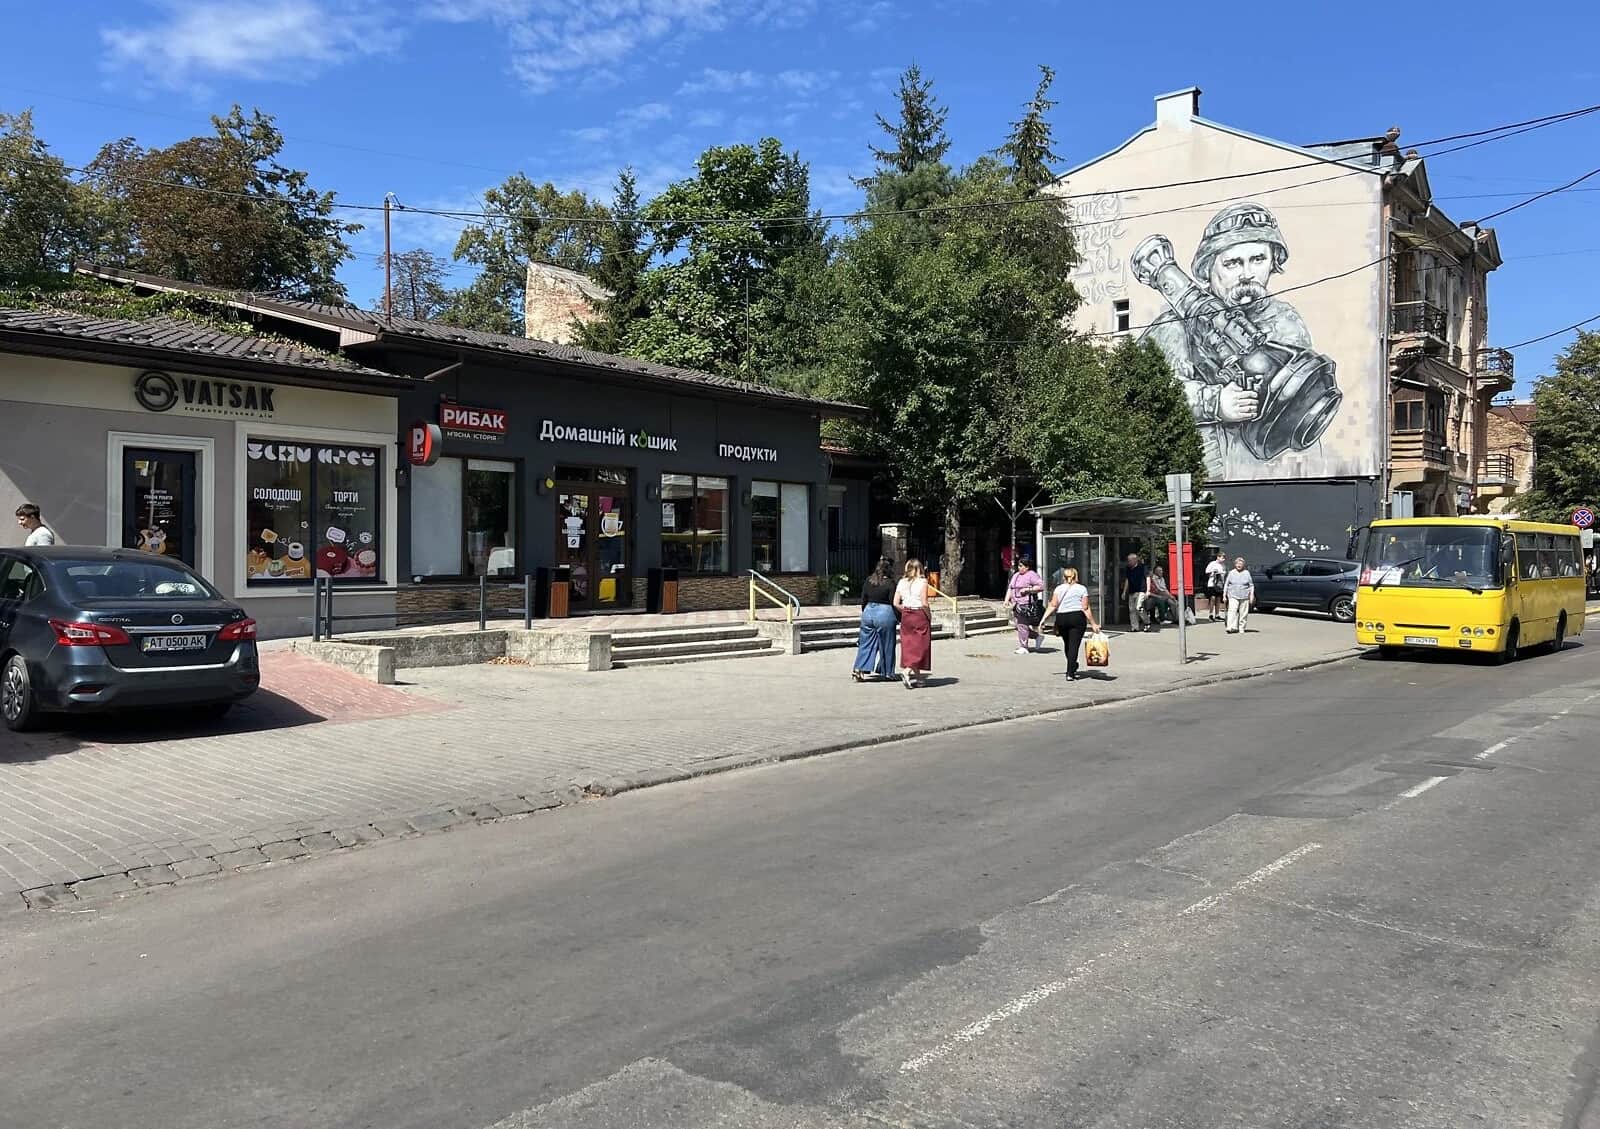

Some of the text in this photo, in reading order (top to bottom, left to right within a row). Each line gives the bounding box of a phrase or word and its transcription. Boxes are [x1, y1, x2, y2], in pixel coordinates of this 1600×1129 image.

[183, 378, 274, 411] VATSAK
[443, 409, 504, 429] РИБАК
[473, 433, 497, 441] ІСТОРІЯ
[540, 420, 677, 452] Домашній кошик
[719, 444, 777, 461] ПРОДУКТИ
[253, 487, 302, 502] СОЛОДОЩІ
[333, 491, 359, 503] ТОРТИ
[150, 635, 204, 648] AT 0500 AK
